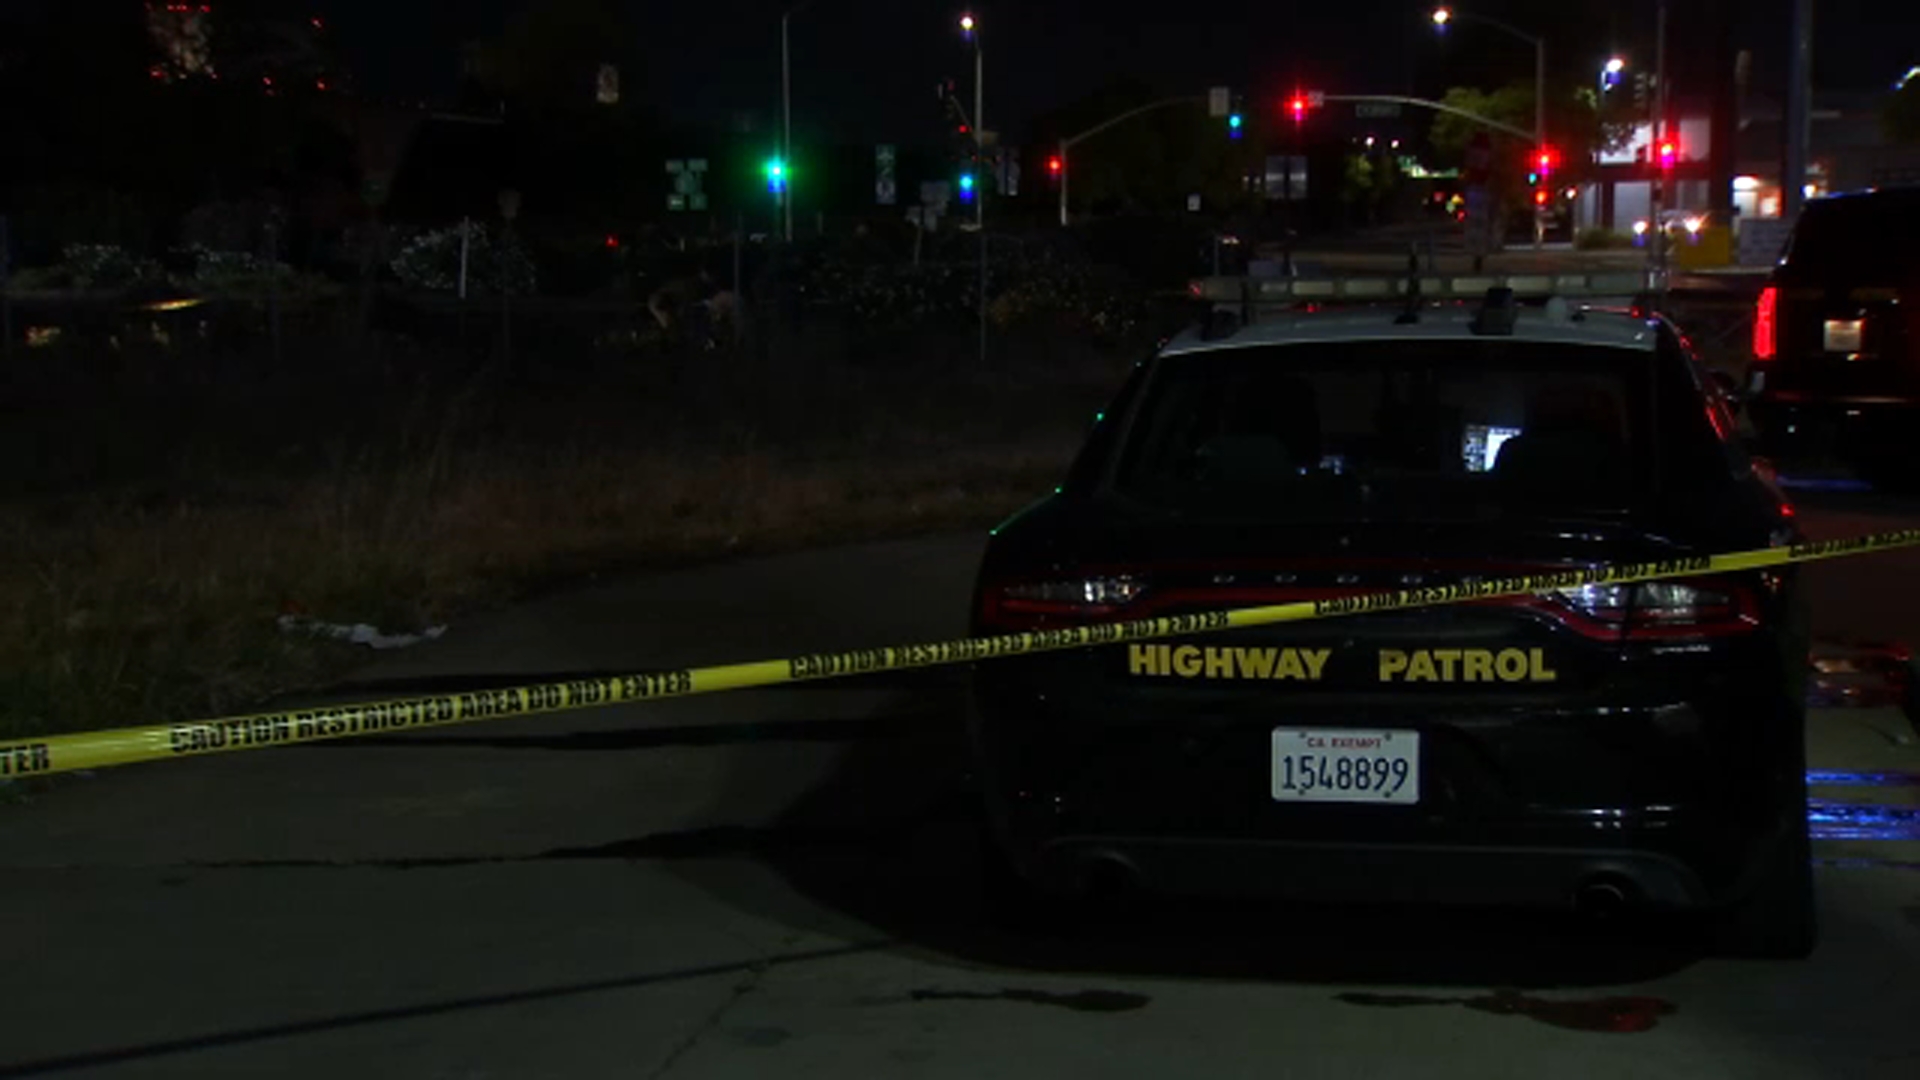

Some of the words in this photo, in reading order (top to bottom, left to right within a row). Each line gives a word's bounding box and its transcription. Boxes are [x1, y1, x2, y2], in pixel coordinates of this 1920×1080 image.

[1314, 594, 1400, 616] CAUTION
[1407, 578, 1525, 603] RESTRICTED
[1531, 572, 1577, 591] AREA
[1584, 569, 1609, 585] DO
[1615, 564, 1649, 580] NOT
[1658, 557, 1711, 575] ENTER
[790, 650, 886, 678] CAUTION
[896, 635, 1025, 666] RESTRICTED
[1032, 629, 1081, 650] AREA
[1089, 626, 1116, 643] DO
[1124, 621, 1158, 639] NOT
[1167, 612, 1229, 633] ENTER
[1129, 644, 1331, 679] HIGHWAY
[1378, 649, 1557, 682] PATROL
[170, 714, 289, 752] CAUTION
[297, 698, 452, 738] RESTRICTED
[459, 688, 522, 719] AREA
[527, 684, 562, 709] DO
[567, 678, 612, 705] NOT
[620, 669, 692, 699] ENTER
[1331, 737, 1382, 749] EXEMPT
[1282, 754, 1408, 793] 1548899
